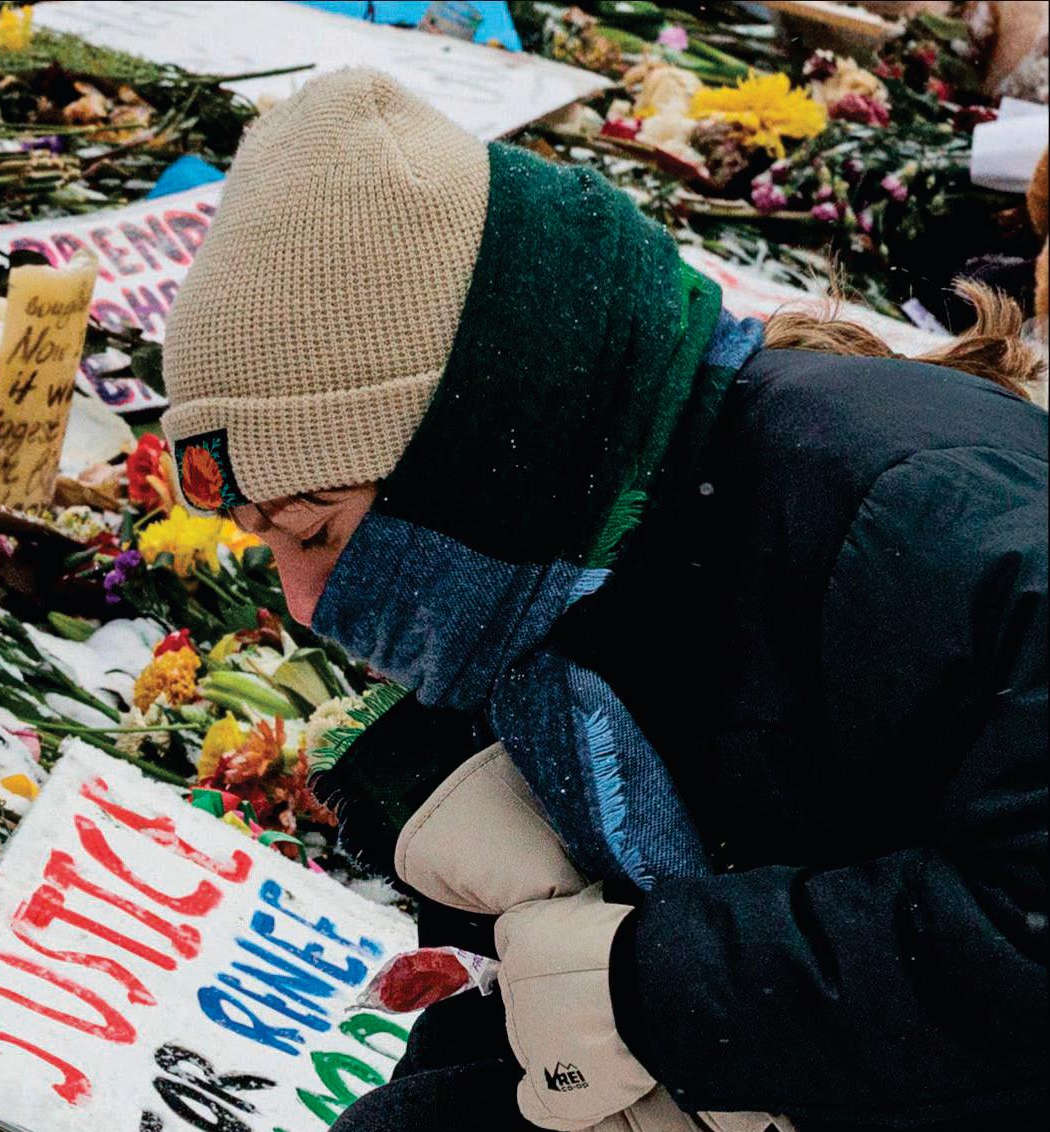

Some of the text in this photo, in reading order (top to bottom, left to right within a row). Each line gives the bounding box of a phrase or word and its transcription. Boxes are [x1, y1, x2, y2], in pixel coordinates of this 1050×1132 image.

[8, 368, 38, 405] it
[197, 878, 384, 1058] RENEE
[557, 1069, 586, 1087] REI
